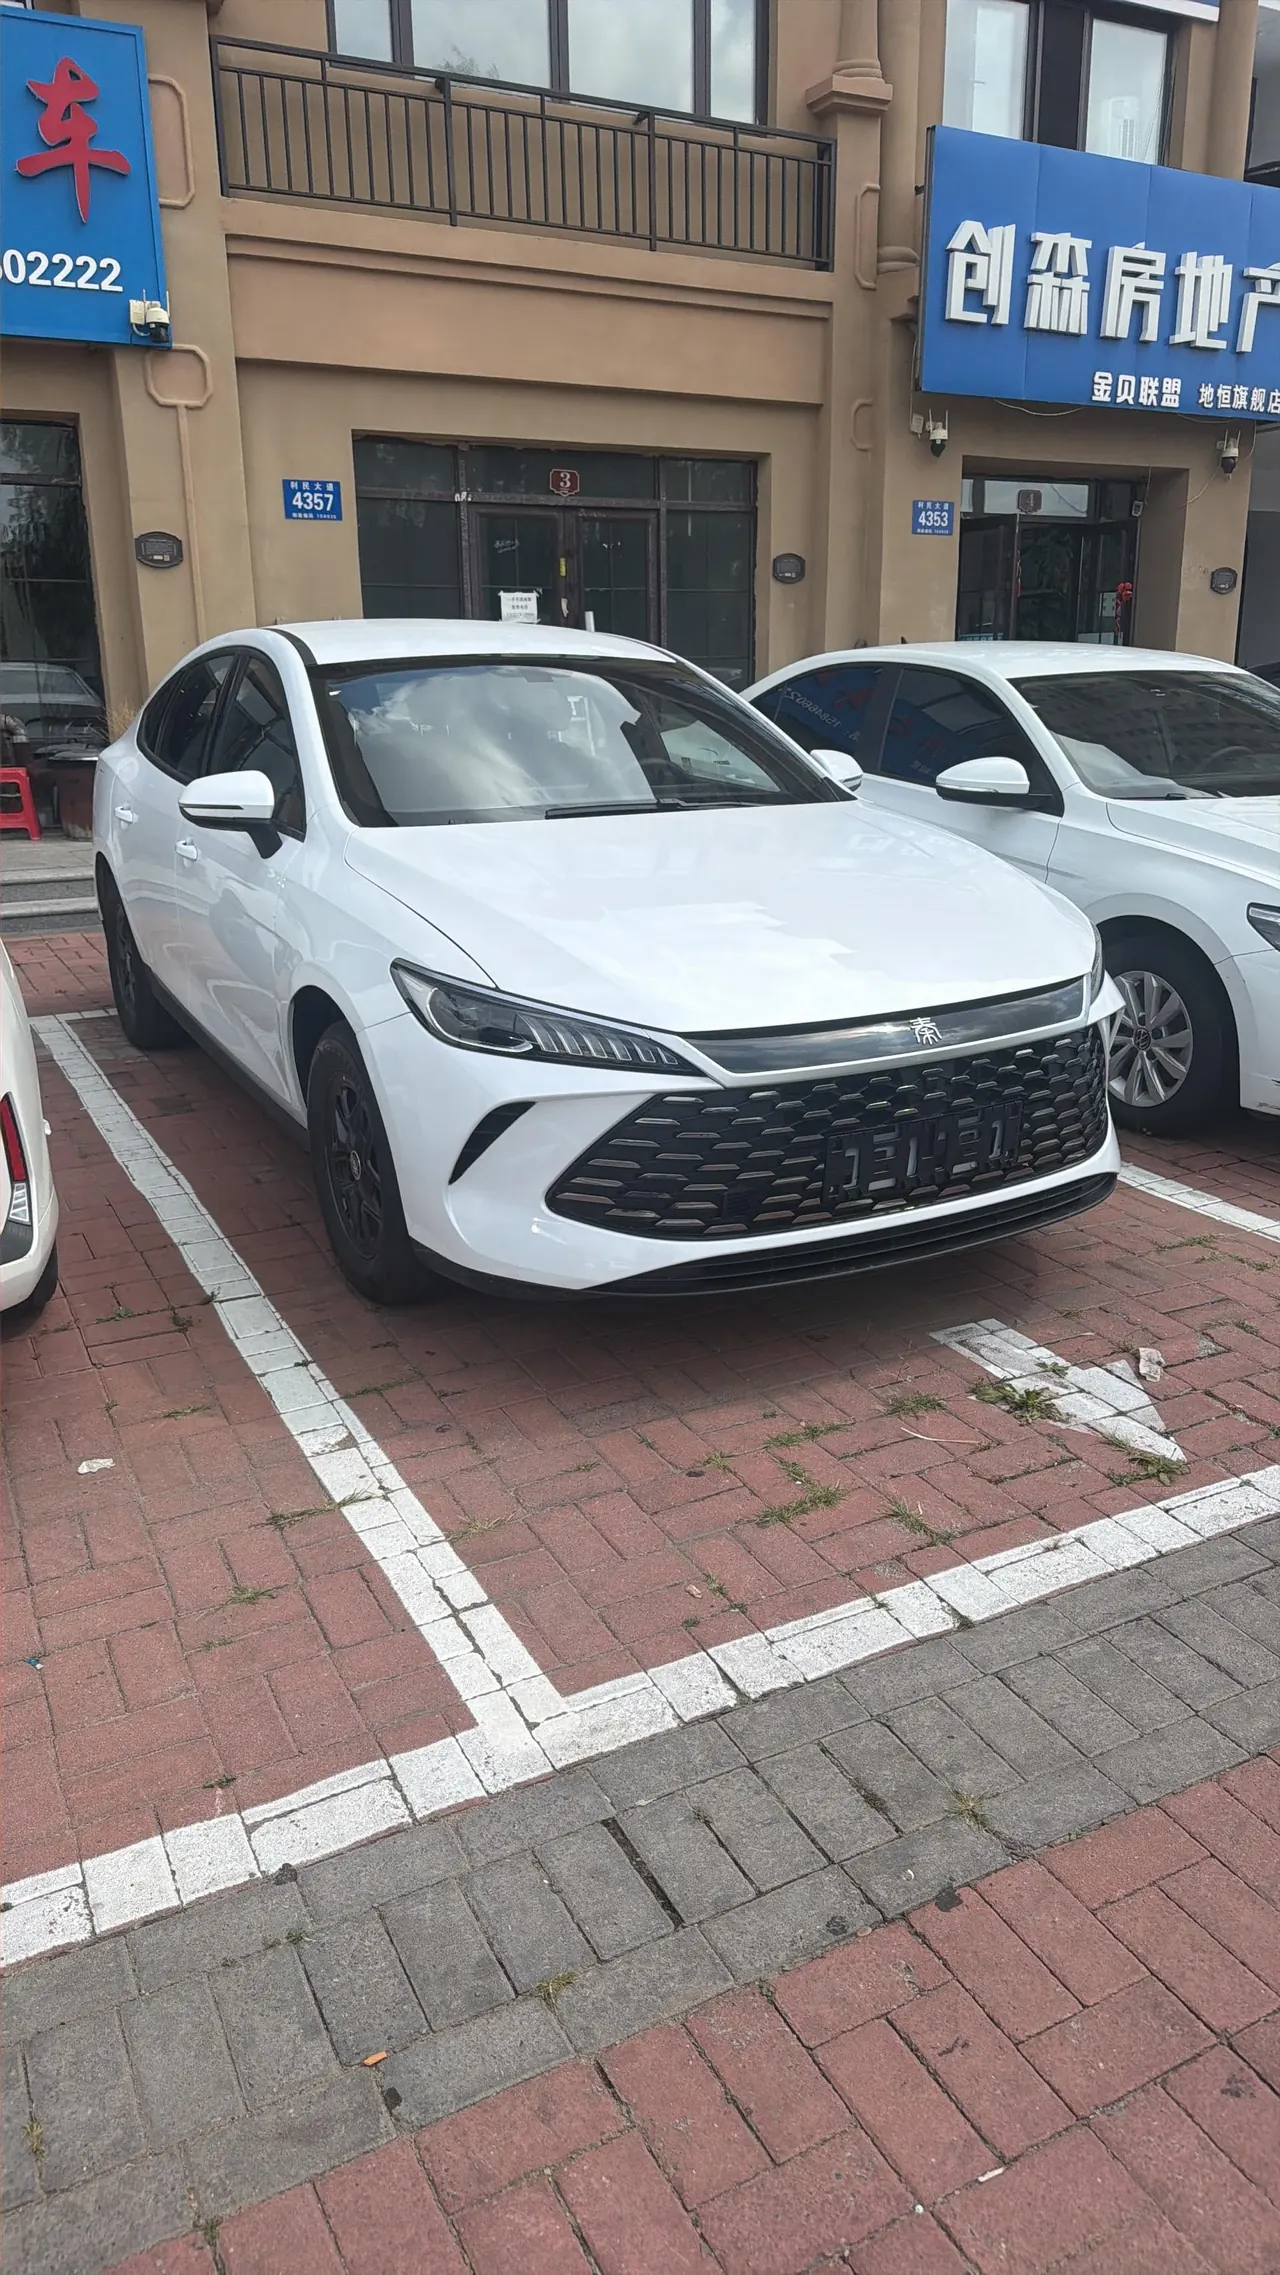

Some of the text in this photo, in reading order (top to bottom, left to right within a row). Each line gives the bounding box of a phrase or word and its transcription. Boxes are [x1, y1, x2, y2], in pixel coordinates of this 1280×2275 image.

[16, 56, 131, 224] 车
[0, 249, 124, 292] 02222
[945, 220, 1280, 353] 创森房地产
[1092, 371, 1280, 414] 金贝联盟 地恒旗舰店
[292, 492, 334, 511] 4357
[560, 472, 571, 488] 3
[918, 511, 949, 527] 4353
